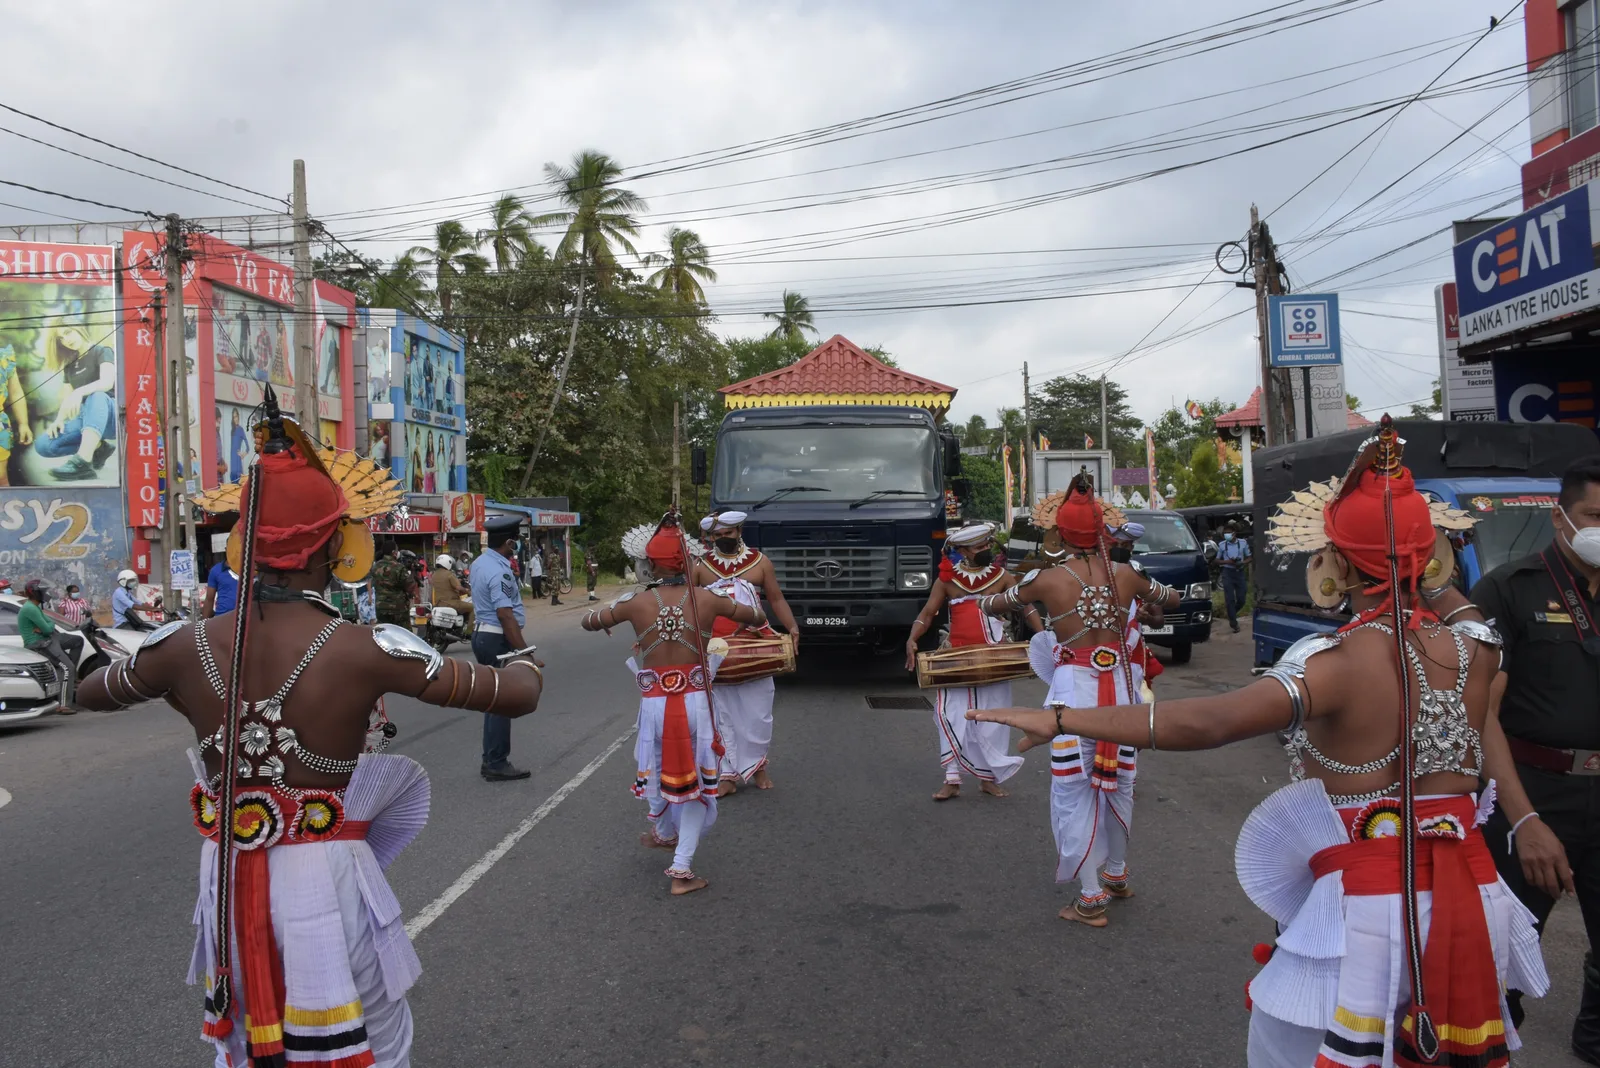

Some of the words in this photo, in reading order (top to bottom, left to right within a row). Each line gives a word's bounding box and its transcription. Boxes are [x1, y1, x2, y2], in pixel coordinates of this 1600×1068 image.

[1472, 204, 1566, 293] CEAT
[231, 252, 259, 294] YR
[1464, 317, 1504, 338] LANKA
[1504, 301, 1538, 326] TYRE
[1541, 278, 1590, 314] HOUSE
[1277, 354, 1303, 362] GENERAL
[1304, 352, 1336, 361] INSURANCE
[136, 374, 156, 526] FASHION
[370, 516, 420, 532] FION
[171, 561, 192, 575] SALE
[824, 617, 846, 626] 9294
[1573, 606, 1590, 630] EOS
